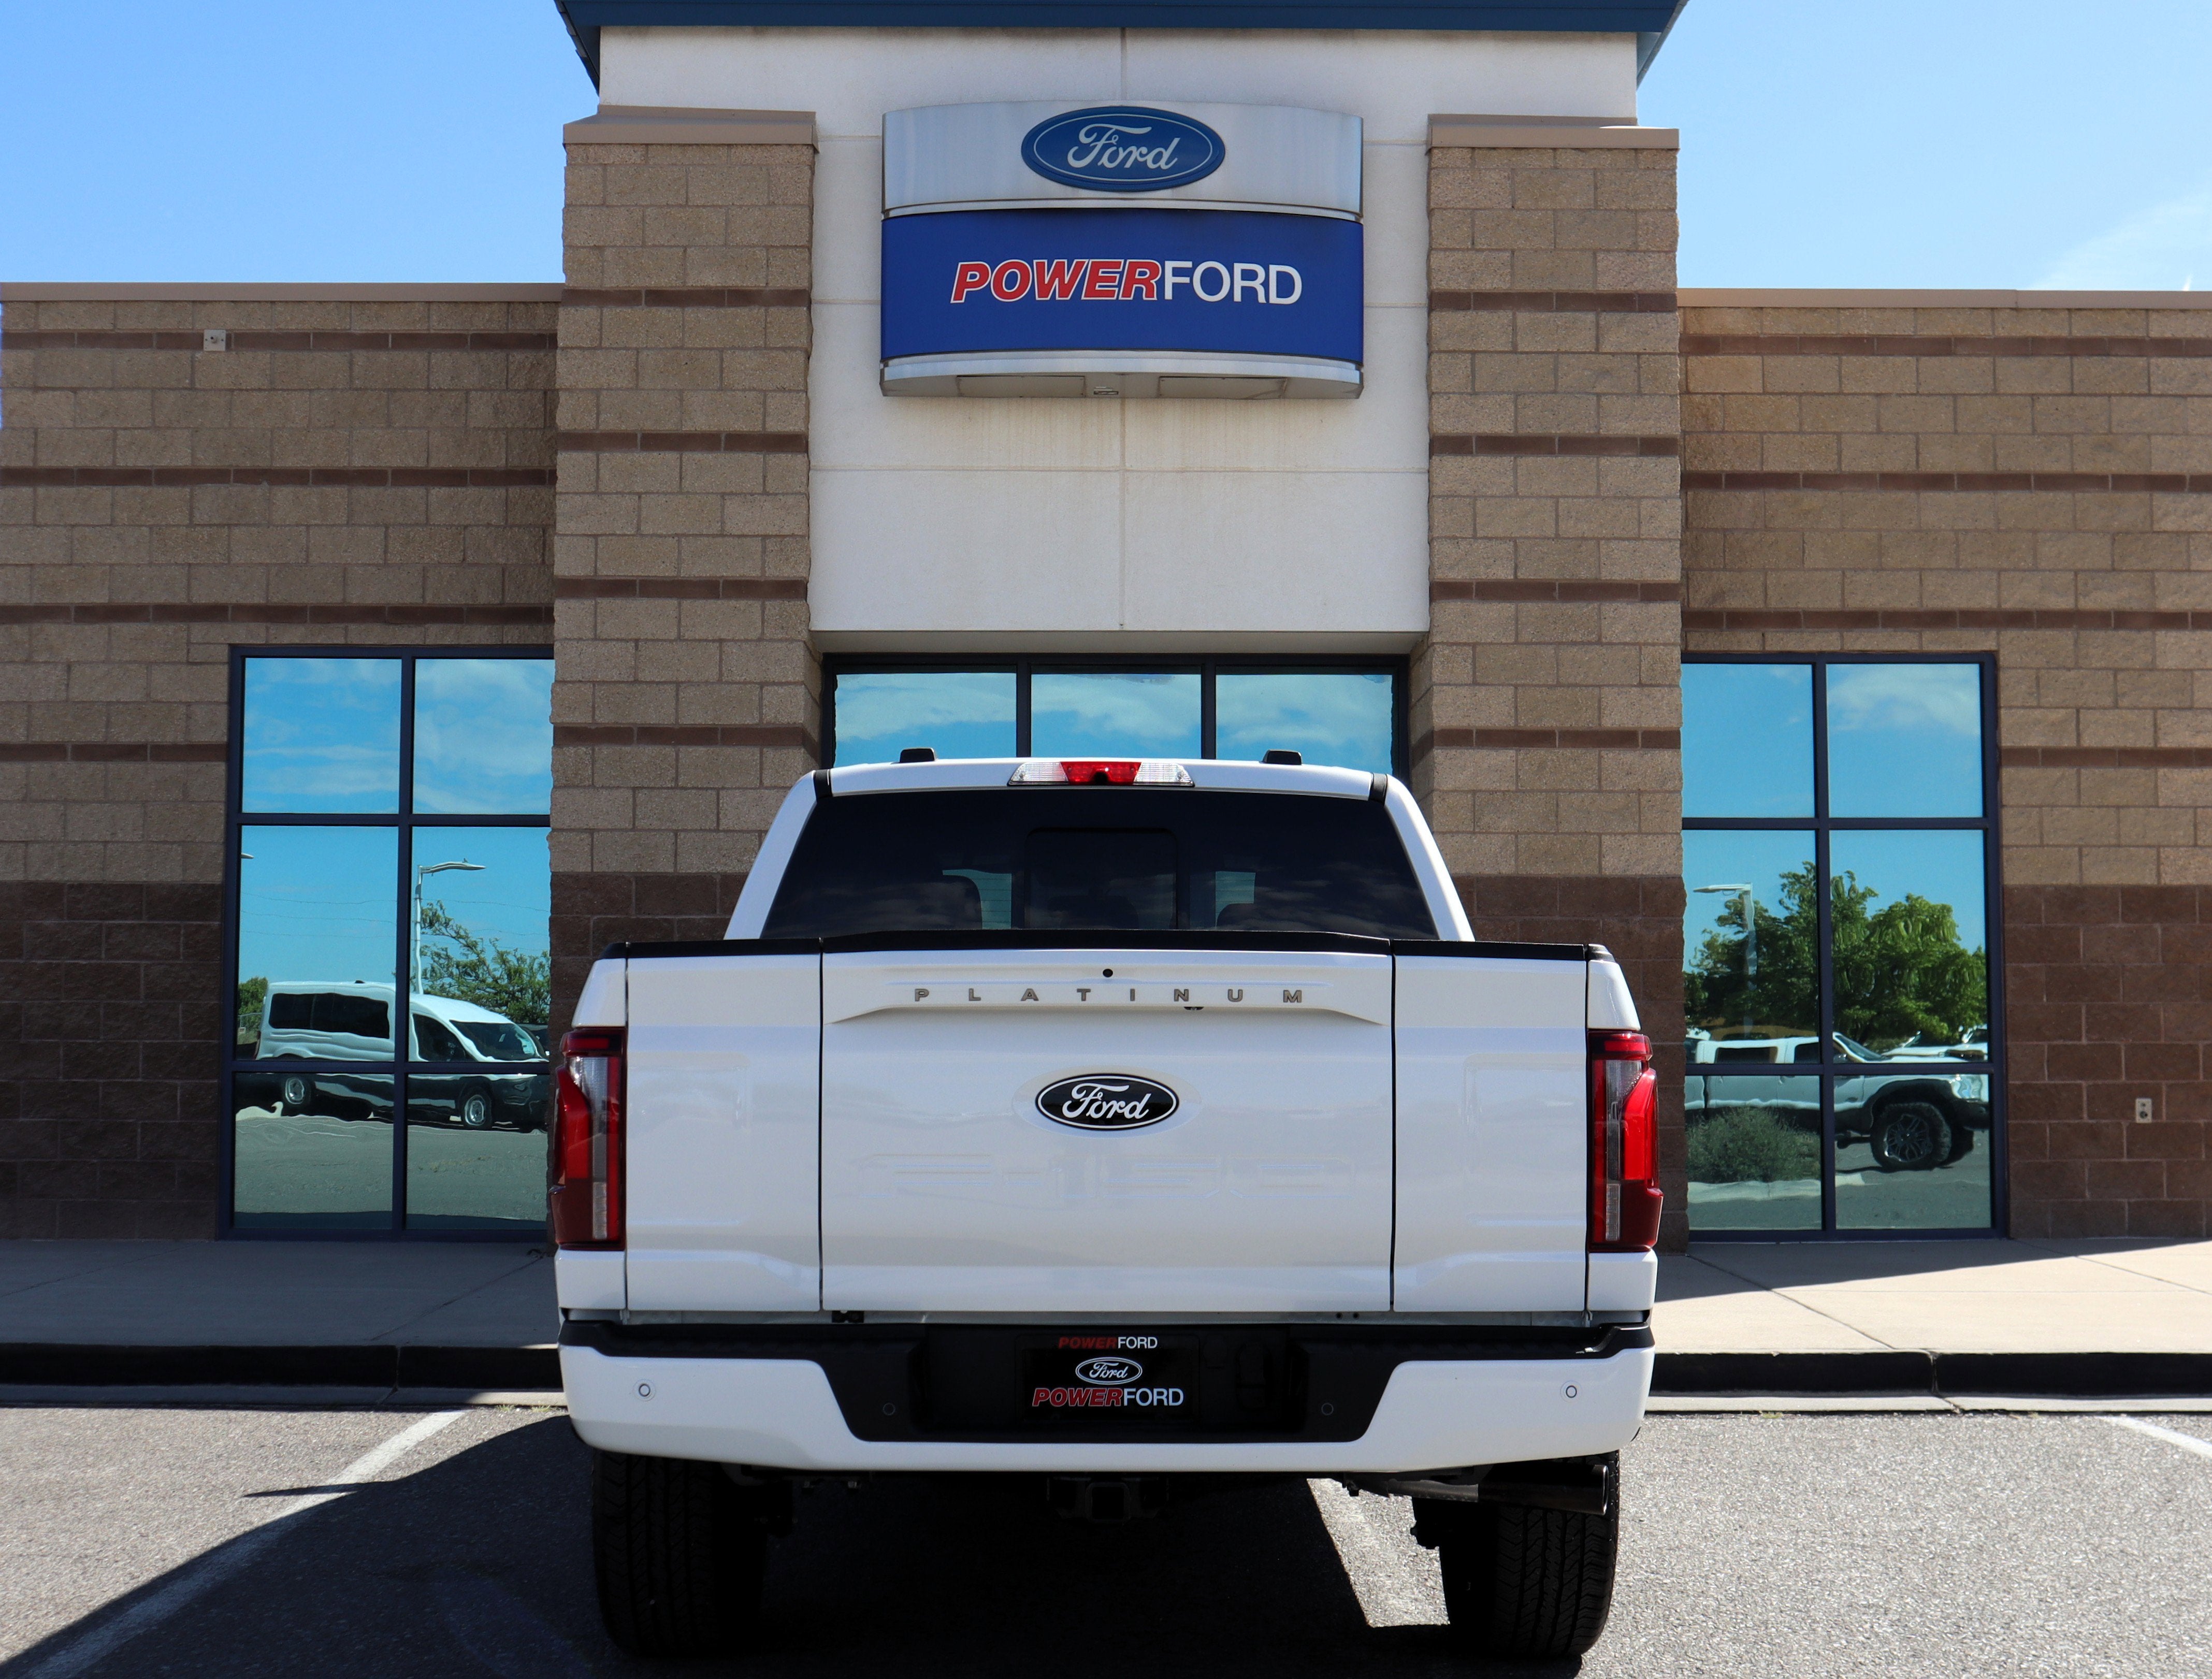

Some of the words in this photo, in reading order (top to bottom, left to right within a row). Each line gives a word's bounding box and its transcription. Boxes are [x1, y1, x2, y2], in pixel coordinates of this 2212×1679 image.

[1067, 123, 1180, 170] Ford
[914, 988, 1303, 1003] PLATINUM
[1062, 1082, 1151, 1119] Ford
[1089, 1362, 1128, 1379] Ford
